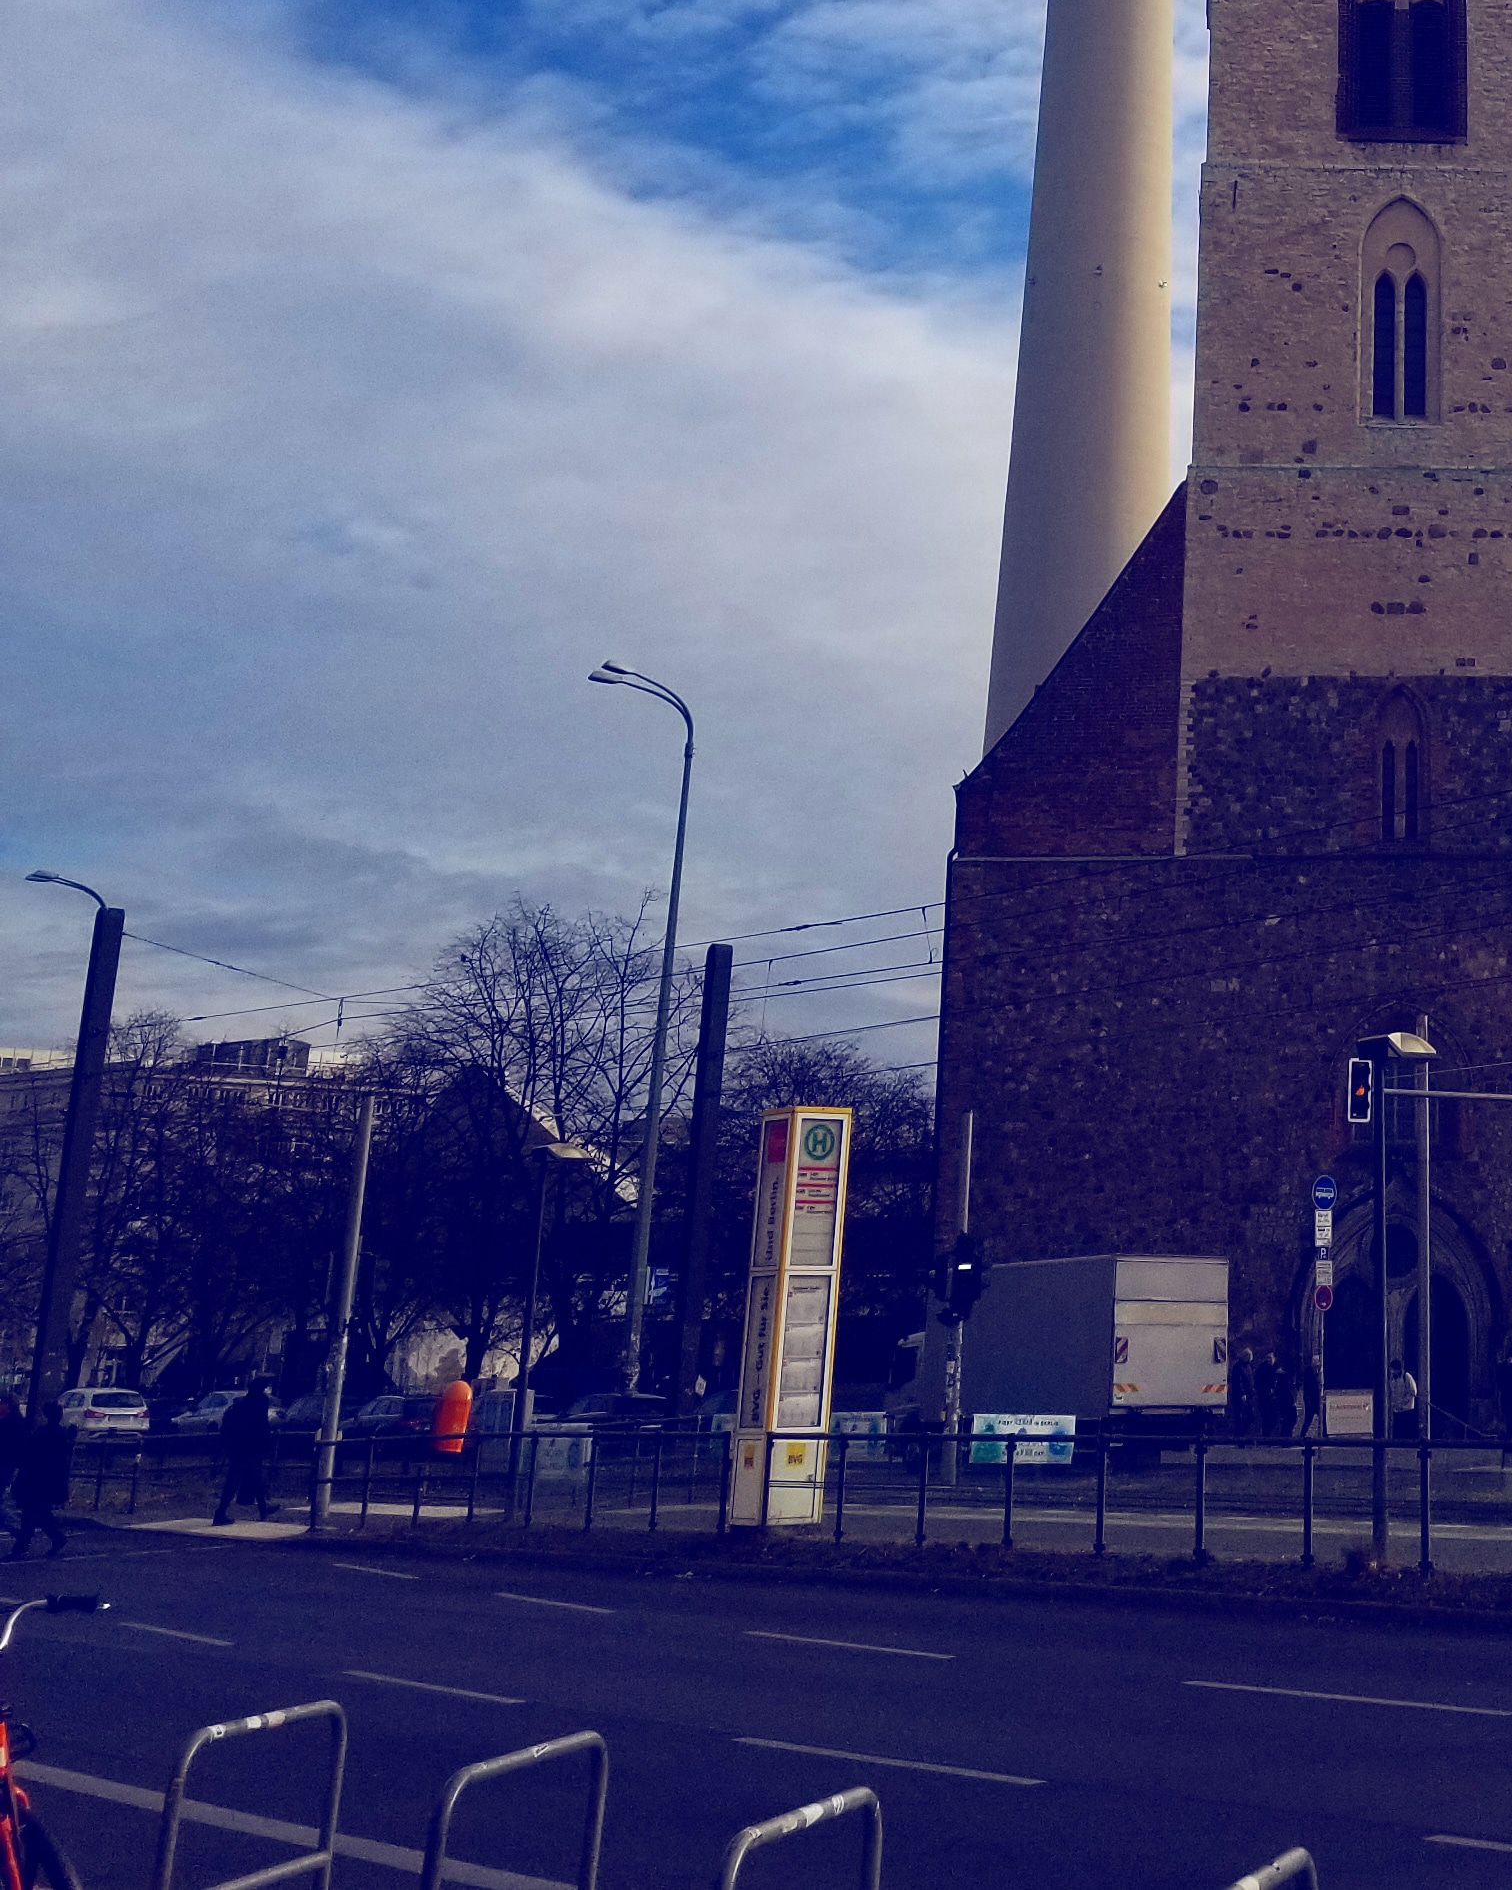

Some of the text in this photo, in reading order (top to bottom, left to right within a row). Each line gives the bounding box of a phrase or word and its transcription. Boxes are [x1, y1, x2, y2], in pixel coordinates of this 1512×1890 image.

[812, 1132, 827, 1152] H
[755, 1342, 765, 1371] Gut
[751, 1388, 761, 1422] BVG
[788, 1454, 803, 1464] BVG
